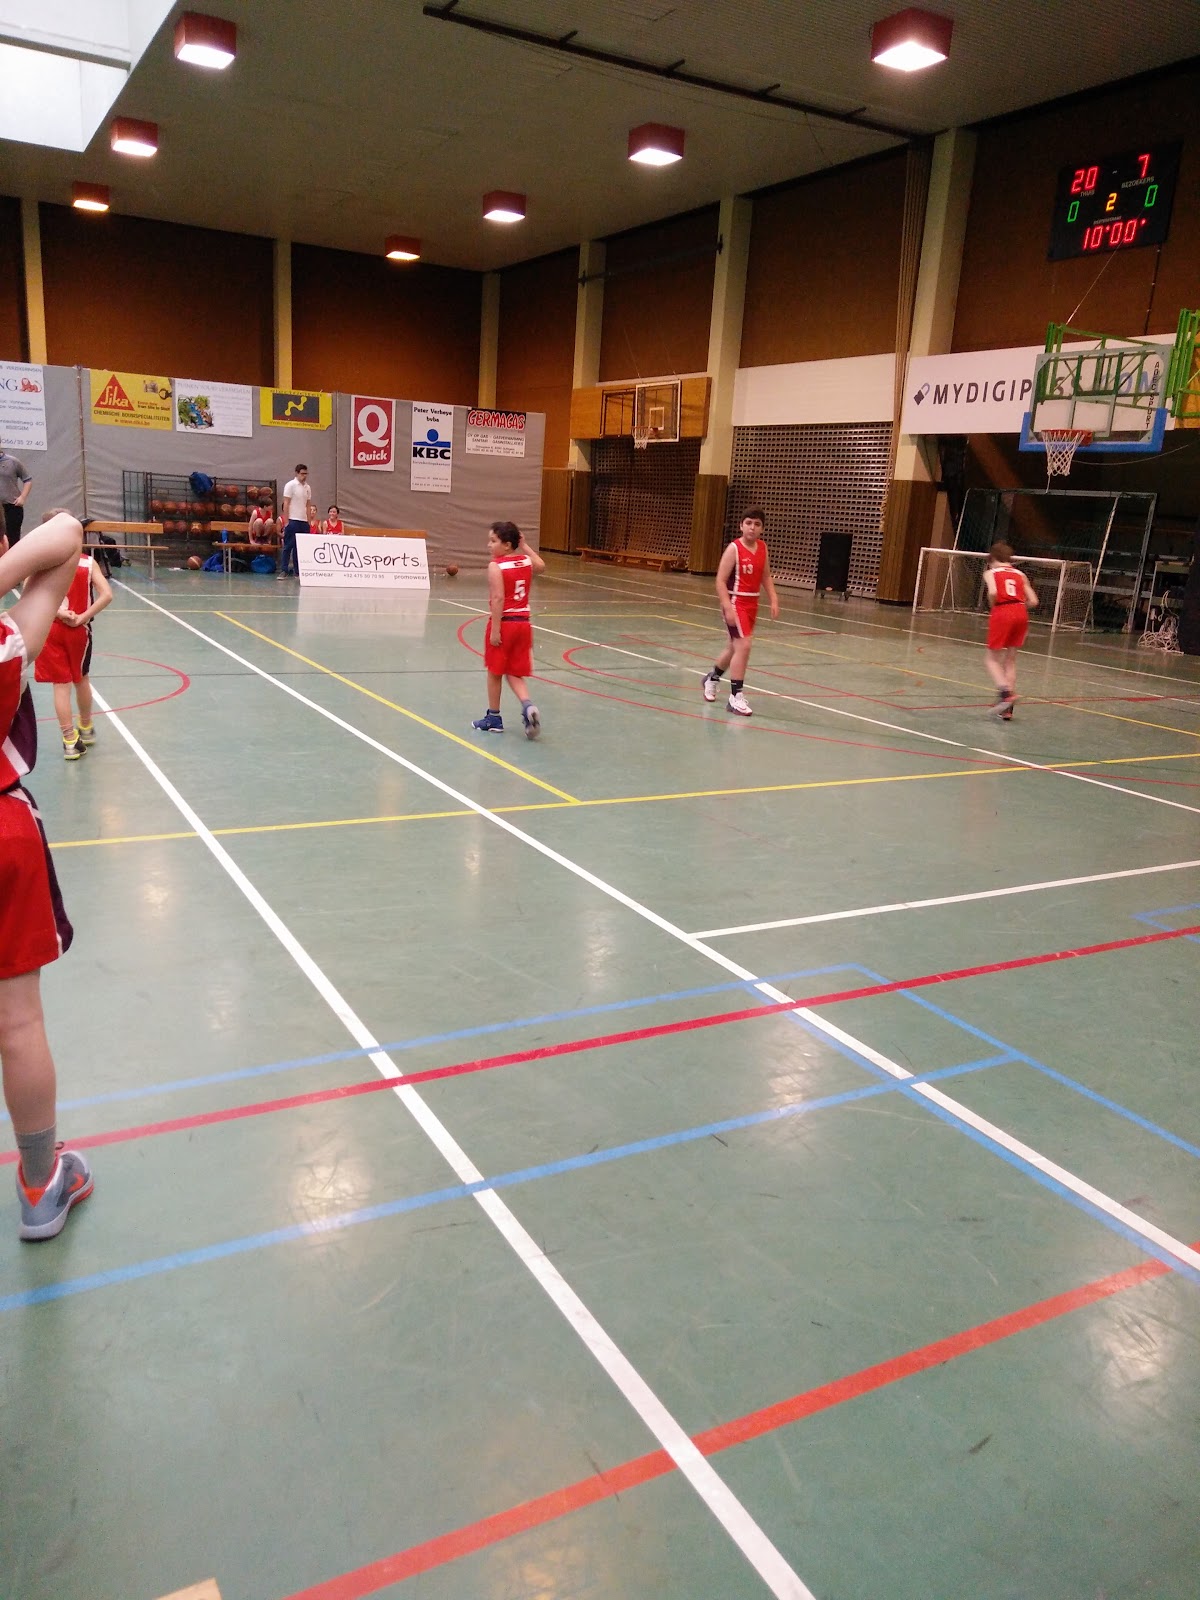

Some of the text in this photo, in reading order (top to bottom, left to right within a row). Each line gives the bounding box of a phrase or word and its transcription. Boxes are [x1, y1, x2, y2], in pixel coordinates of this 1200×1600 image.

[1138, 153, 1150, 178] 7
[1071, 166, 1098, 193] 20
[1106, 193, 1117, 211] 2
[1144, 185, 1158, 207] 0
[1067, 201, 1079, 222] 0
[100, 385, 130, 408] Sika
[413, 406, 429, 414] Peter
[467, 410, 526, 431] GERMAGAS
[357, 449, 388, 462] Quick
[412, 446, 451, 460] KBC
[301, 570, 334, 578] sportwear
[741, 563, 754, 575] 13
[513, 579, 526, 601] 5
[1004, 578, 1017, 597] 6
